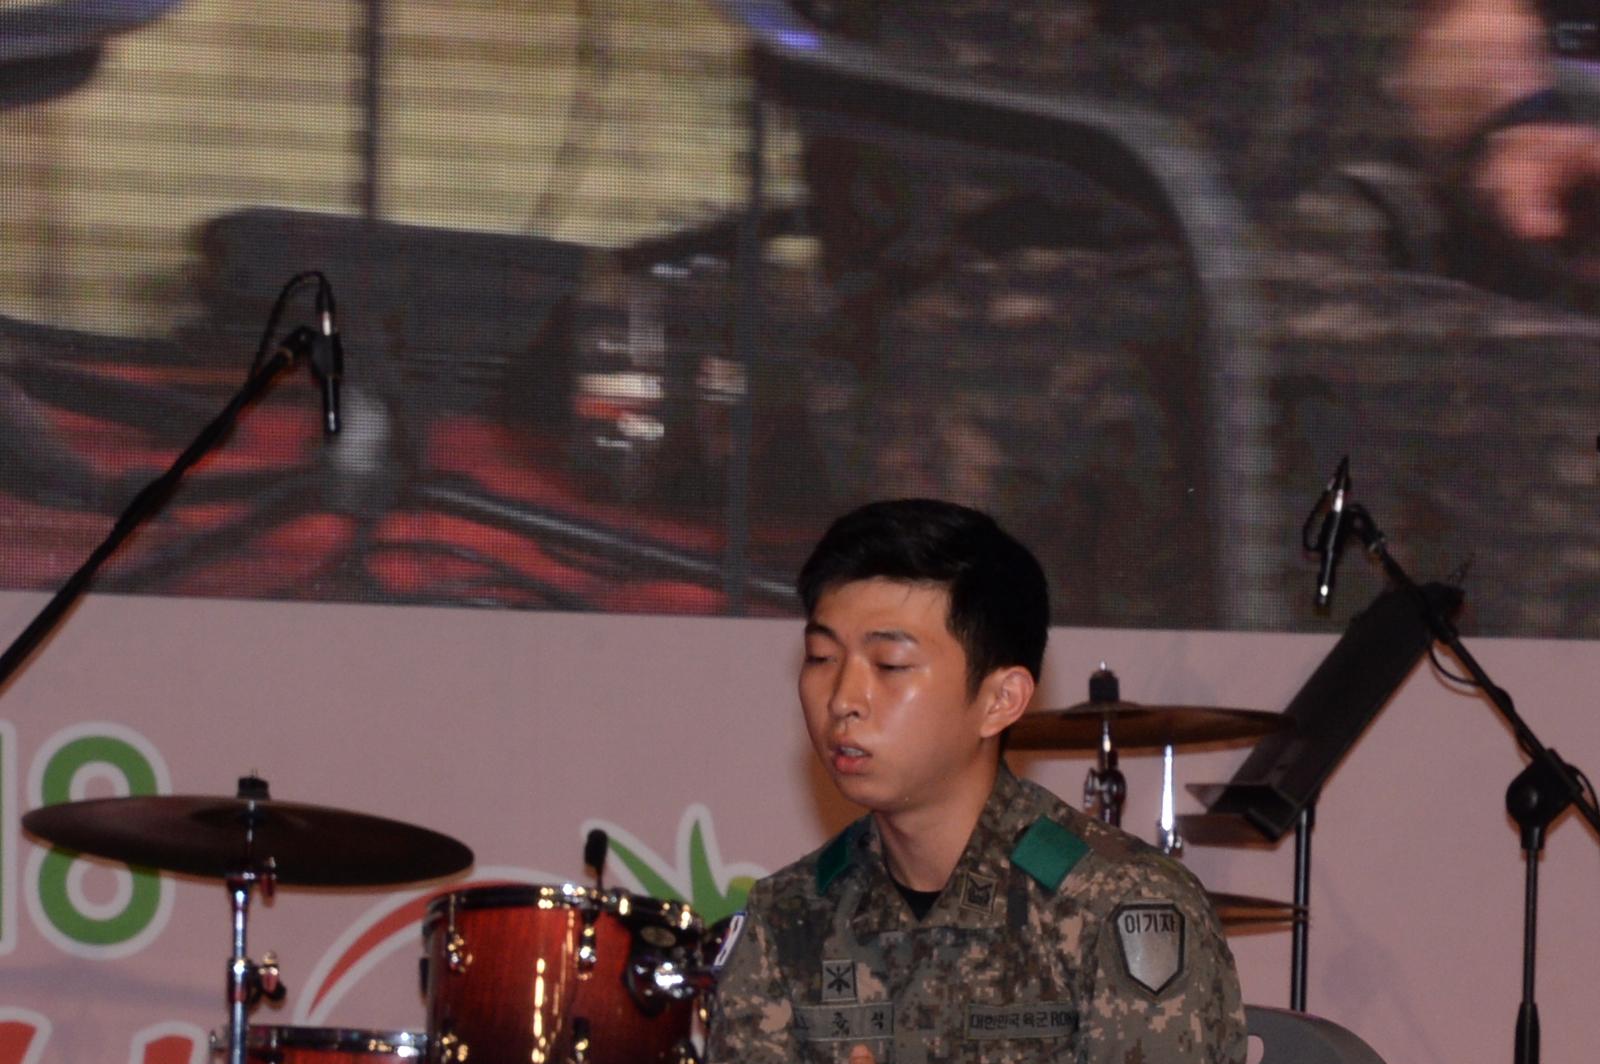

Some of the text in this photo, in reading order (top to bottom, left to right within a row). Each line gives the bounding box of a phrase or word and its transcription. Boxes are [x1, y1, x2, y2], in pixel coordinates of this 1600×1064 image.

[0, 733, 162, 946] 8
[1125, 913, 1176, 934] 이기자
[970, 1012, 1020, 1031] 대한민국
[1022, 1011, 1048, 1029] 육군
